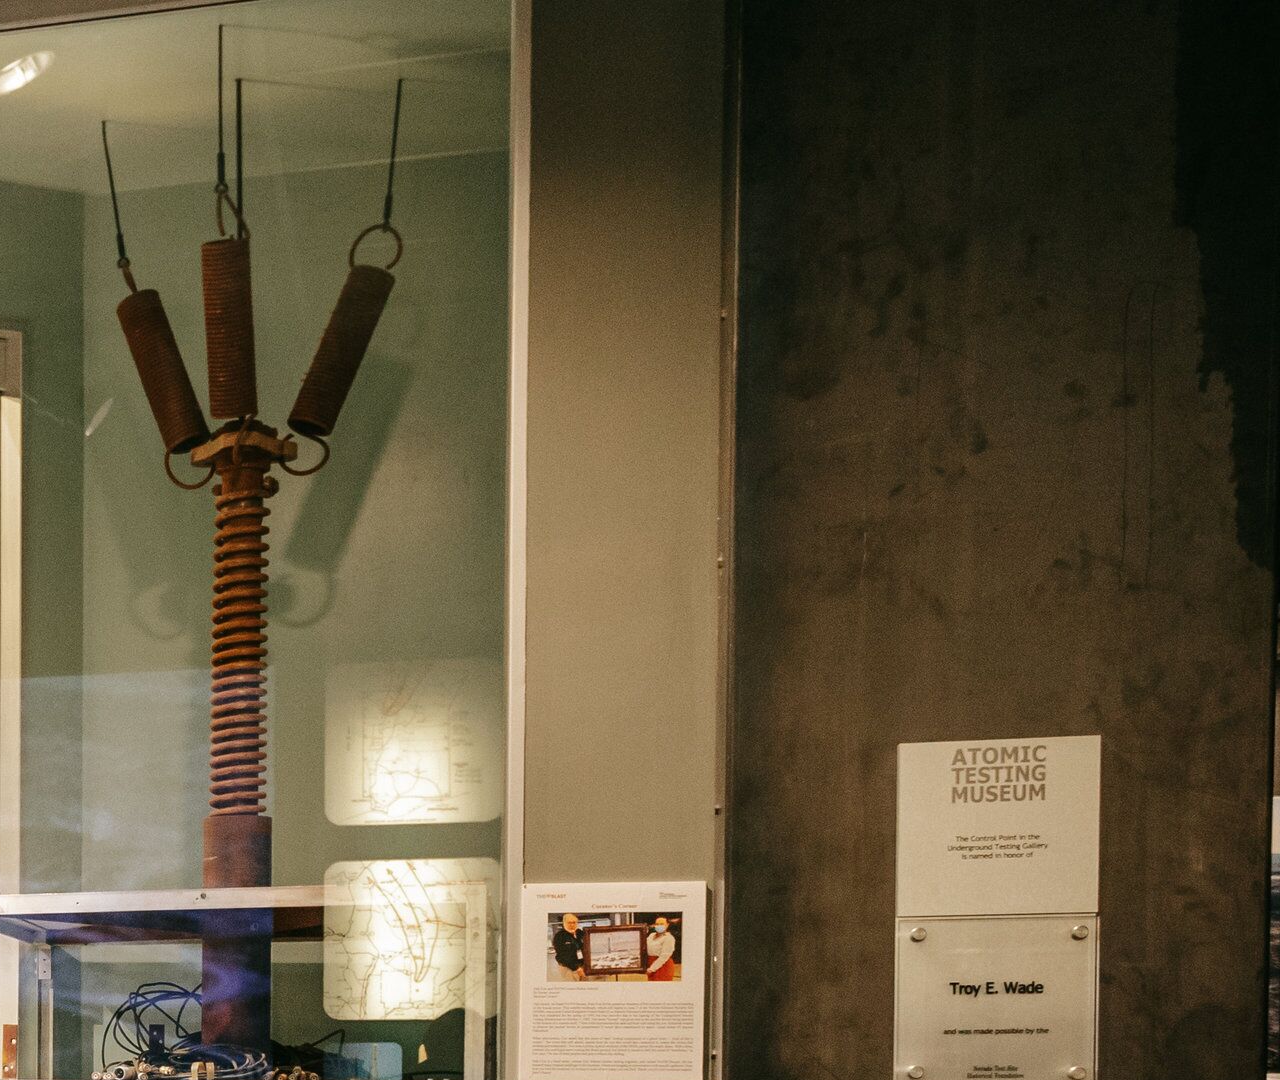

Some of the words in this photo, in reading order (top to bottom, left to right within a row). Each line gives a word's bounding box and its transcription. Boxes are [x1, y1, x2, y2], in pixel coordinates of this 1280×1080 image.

[951, 744, 1047, 766] ATOMIC
[951, 764, 1047, 785] TESTING
[951, 783, 1046, 803] MUSEUM
[947, 844, 993, 852] Underground
[994, 843, 1021, 851] Testing
[1021, 842, 1049, 850] Gallery
[949, 982, 982, 998] Troy
[985, 981, 999, 995] E.
[1003, 981, 1044, 994] Wade
[994, 1028, 1024, 1036] possible
